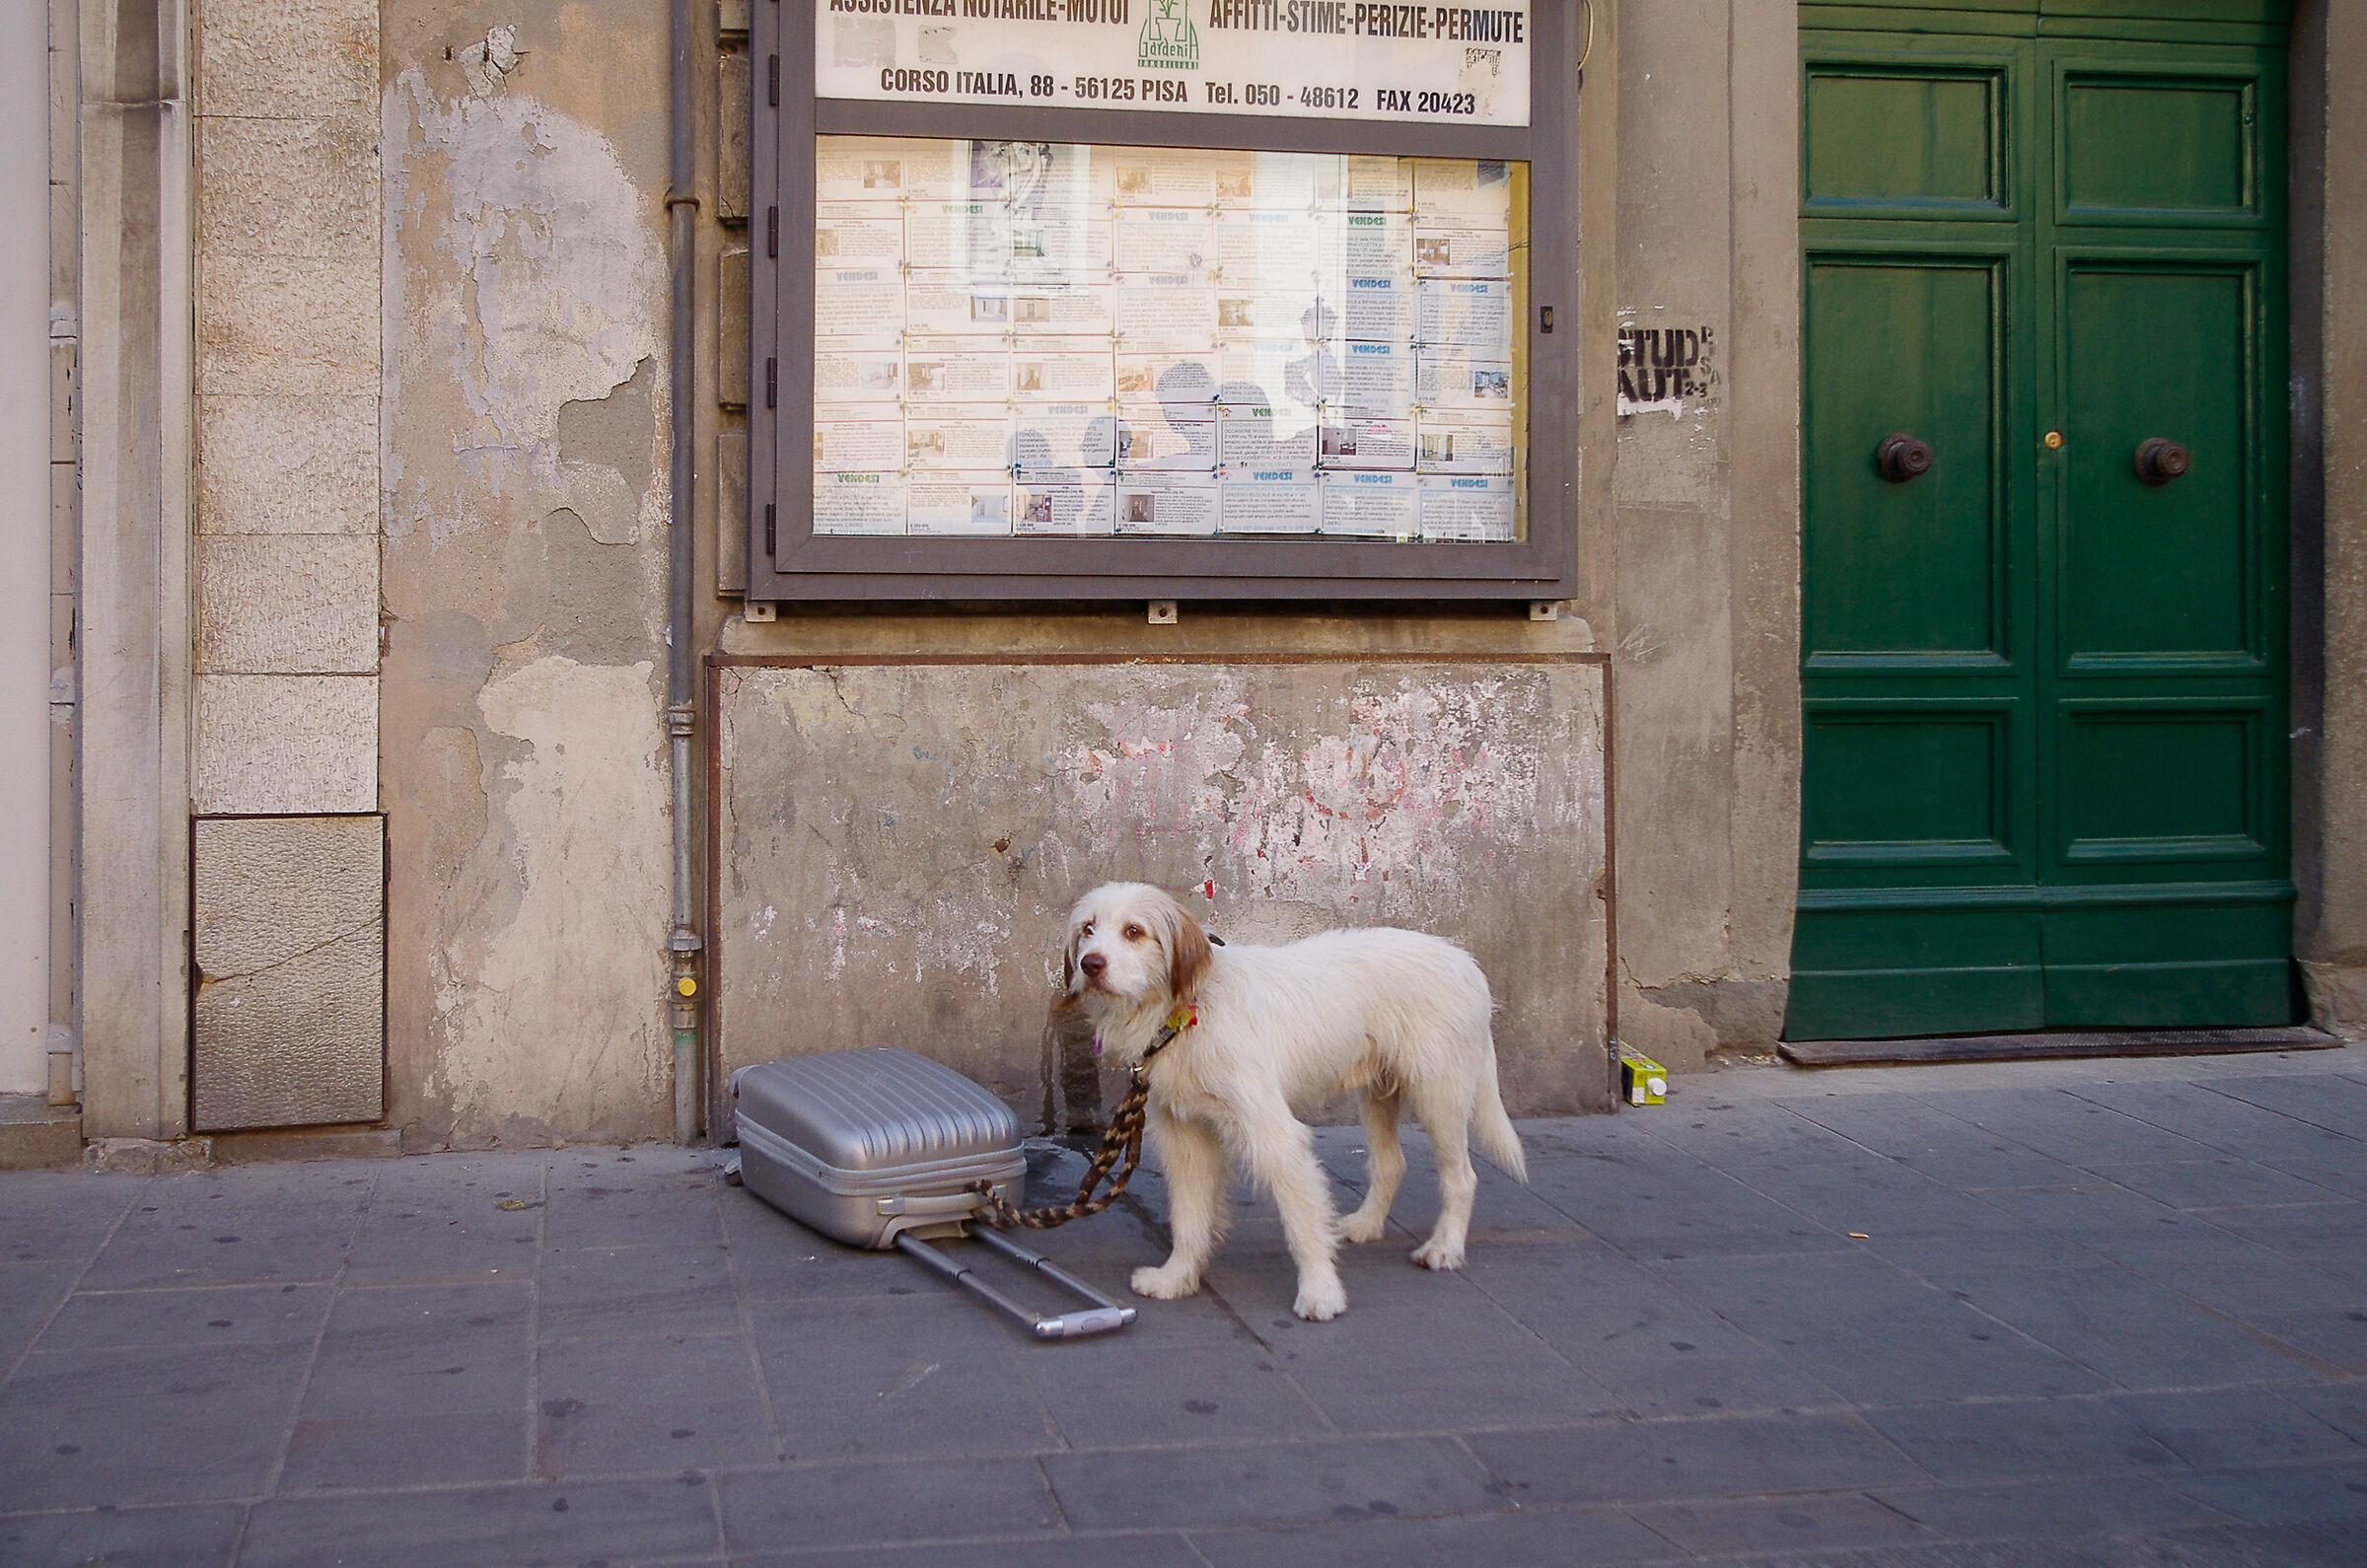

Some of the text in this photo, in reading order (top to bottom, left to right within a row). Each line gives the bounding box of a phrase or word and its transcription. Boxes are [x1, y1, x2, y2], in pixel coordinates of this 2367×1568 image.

[881, 68, 949, 93] CORSO
[956, 71, 1024, 99] ITALIA,
[1030, 75, 1054, 97] 88
[1075, 77, 1135, 101] 56125
[1141, 79, 1187, 103] PISA
[1205, 82, 1238, 105] Tel.
[1245, 84, 1280, 107] 050
[1300, 86, 1359, 109] 48612
[1377, 89, 1411, 112] FAX
[1417, 92, 1475, 115] 20423
[1352, 279, 1391, 289] VENDESI
[1352, 344, 1391, 354] VENDESI
[1254, 471, 1293, 481] VENDESI
[1354, 474, 1393, 484] VENDESI
[1451, 478, 1488, 488] VENDESI
